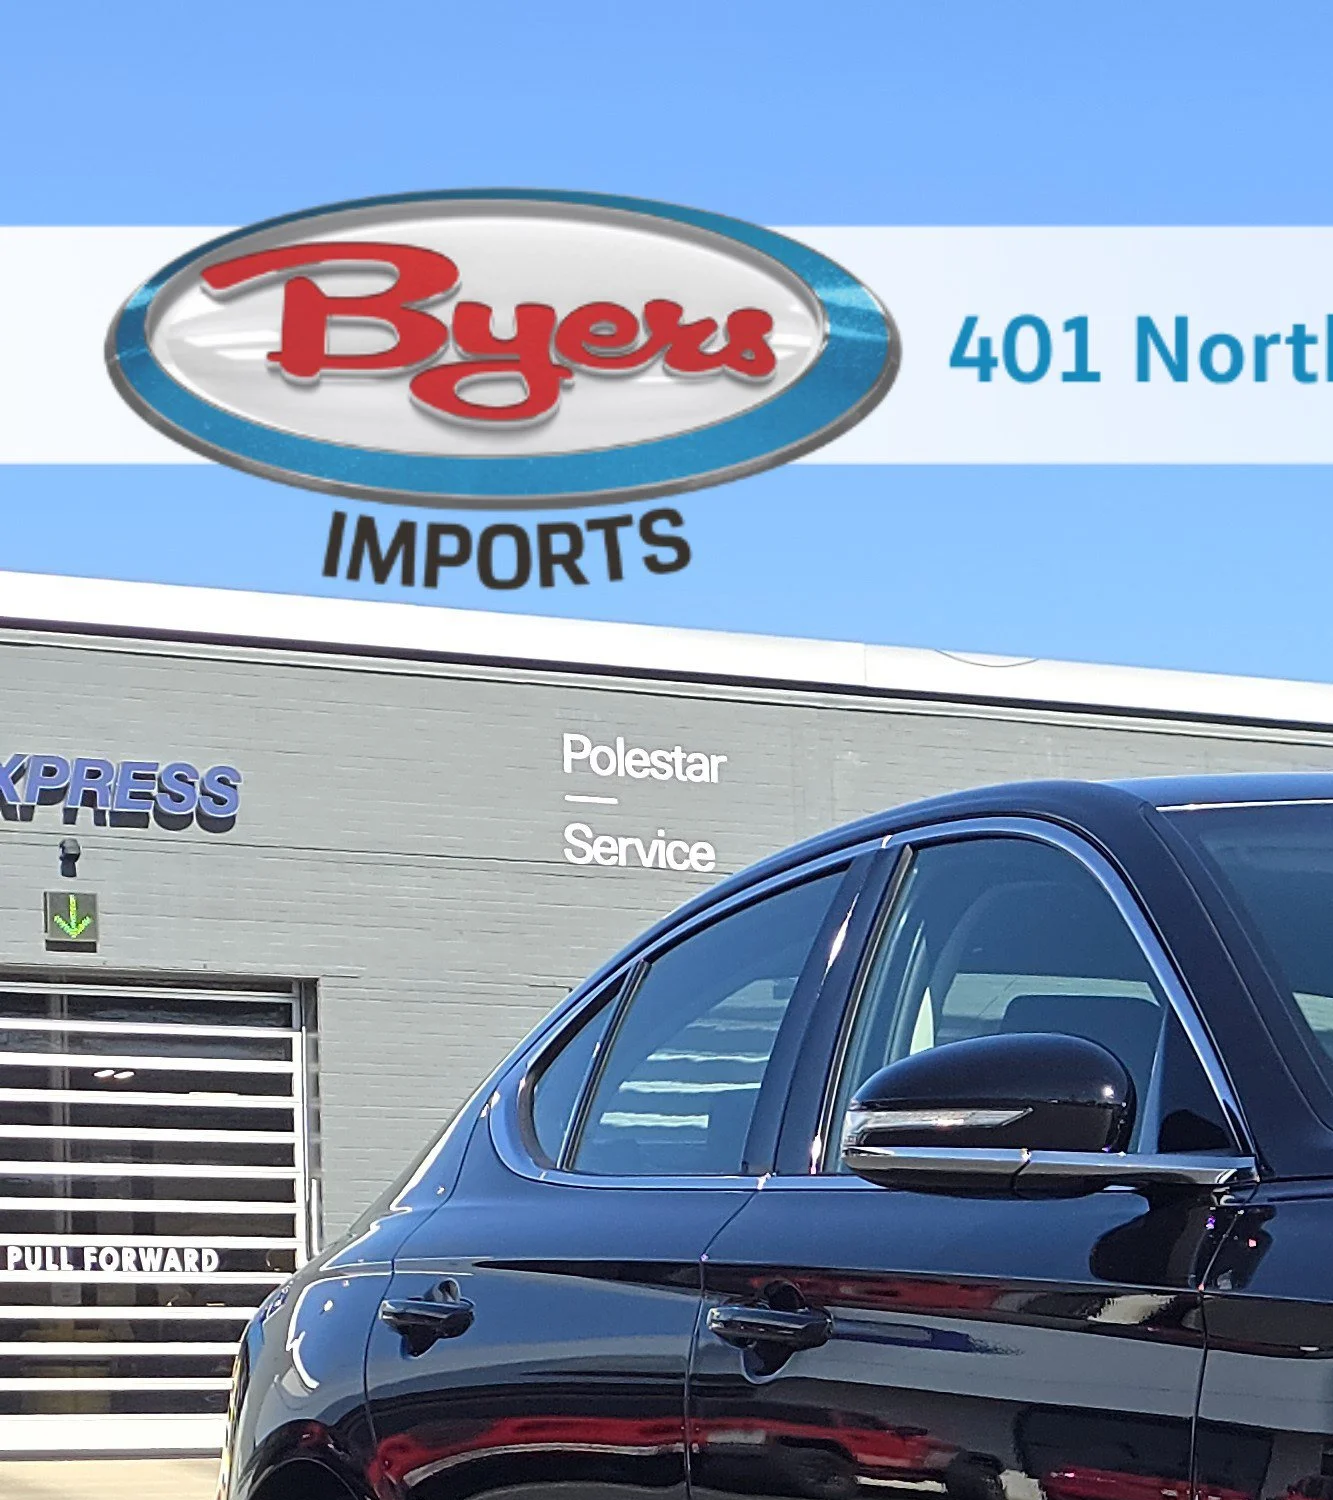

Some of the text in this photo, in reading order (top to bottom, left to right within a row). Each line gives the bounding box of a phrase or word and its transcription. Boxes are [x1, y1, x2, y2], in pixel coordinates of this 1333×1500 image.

[563, 732, 728, 784] Polestar
[563, 822, 716, 873] Service
[7, 1245, 220, 1272] PULL FORWARD
